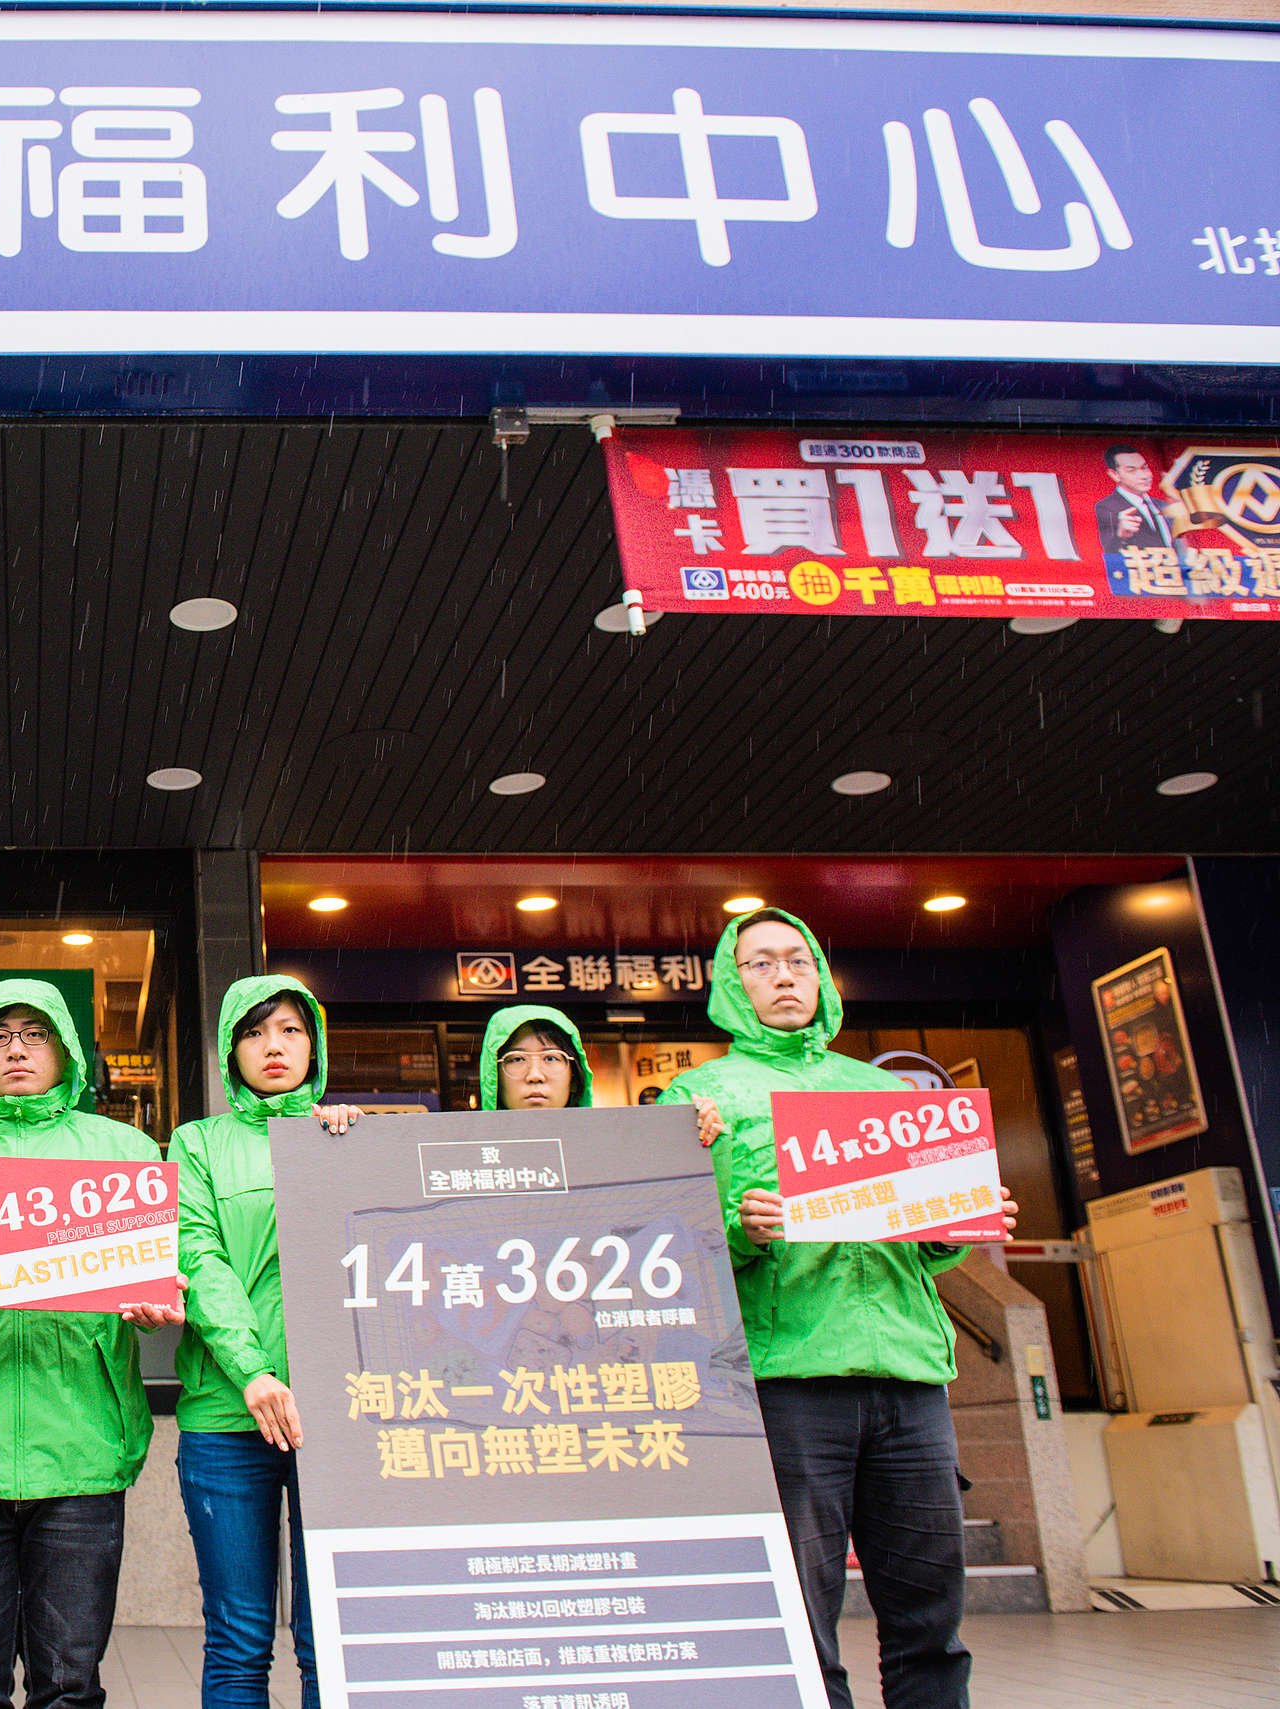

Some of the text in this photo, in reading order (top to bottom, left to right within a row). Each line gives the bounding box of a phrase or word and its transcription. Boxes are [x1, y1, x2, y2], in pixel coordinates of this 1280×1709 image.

[726, 467, 1082, 561] 買1送1
[732, 583, 791, 600] 400元
[522, 955, 714, 992] 全聯福利
[781, 1096, 980, 1173] 14萬3626
[480, 1146, 502, 1165] 致
[428, 1167, 560, 1192] 全聯福利中心
[789, 1180, 898, 1224] #超市減塑
[886, 1185, 994, 1230] #誰當先鋒
[47, 1208, 176, 1245] PEOPLE SUPPORT
[343, 1361, 702, 1422] 淘汰一次性塑膠
[377, 1420, 690, 1480] 邁向無塑未來
[467, 1552, 638, 1576] 積極制定長期減塑計畫
[474, 1597, 646, 1622] 淘汰難以回收塑膠包裝
